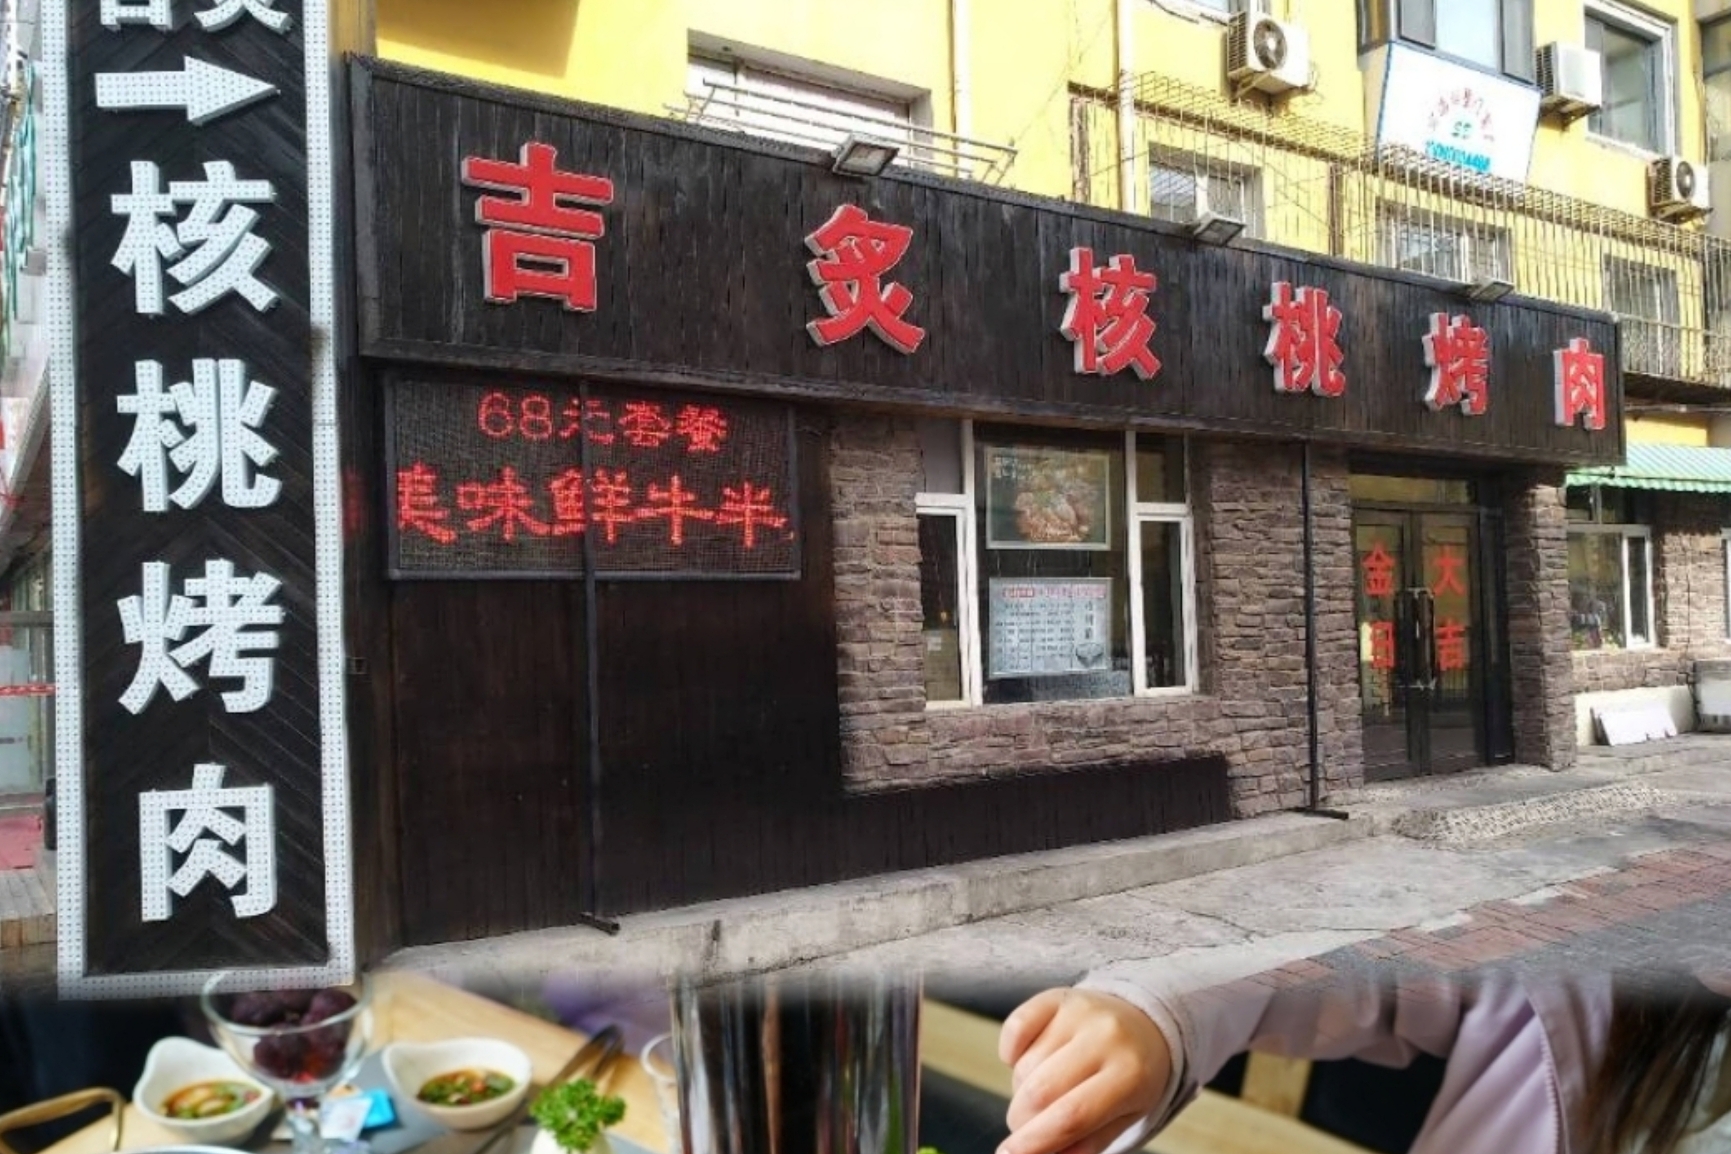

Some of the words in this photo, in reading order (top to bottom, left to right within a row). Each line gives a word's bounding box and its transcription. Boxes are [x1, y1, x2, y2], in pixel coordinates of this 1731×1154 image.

[110, 159, 287, 923] 核桃烤肉
[461, 140, 1606, 430] 吉炙核桃烤肉
